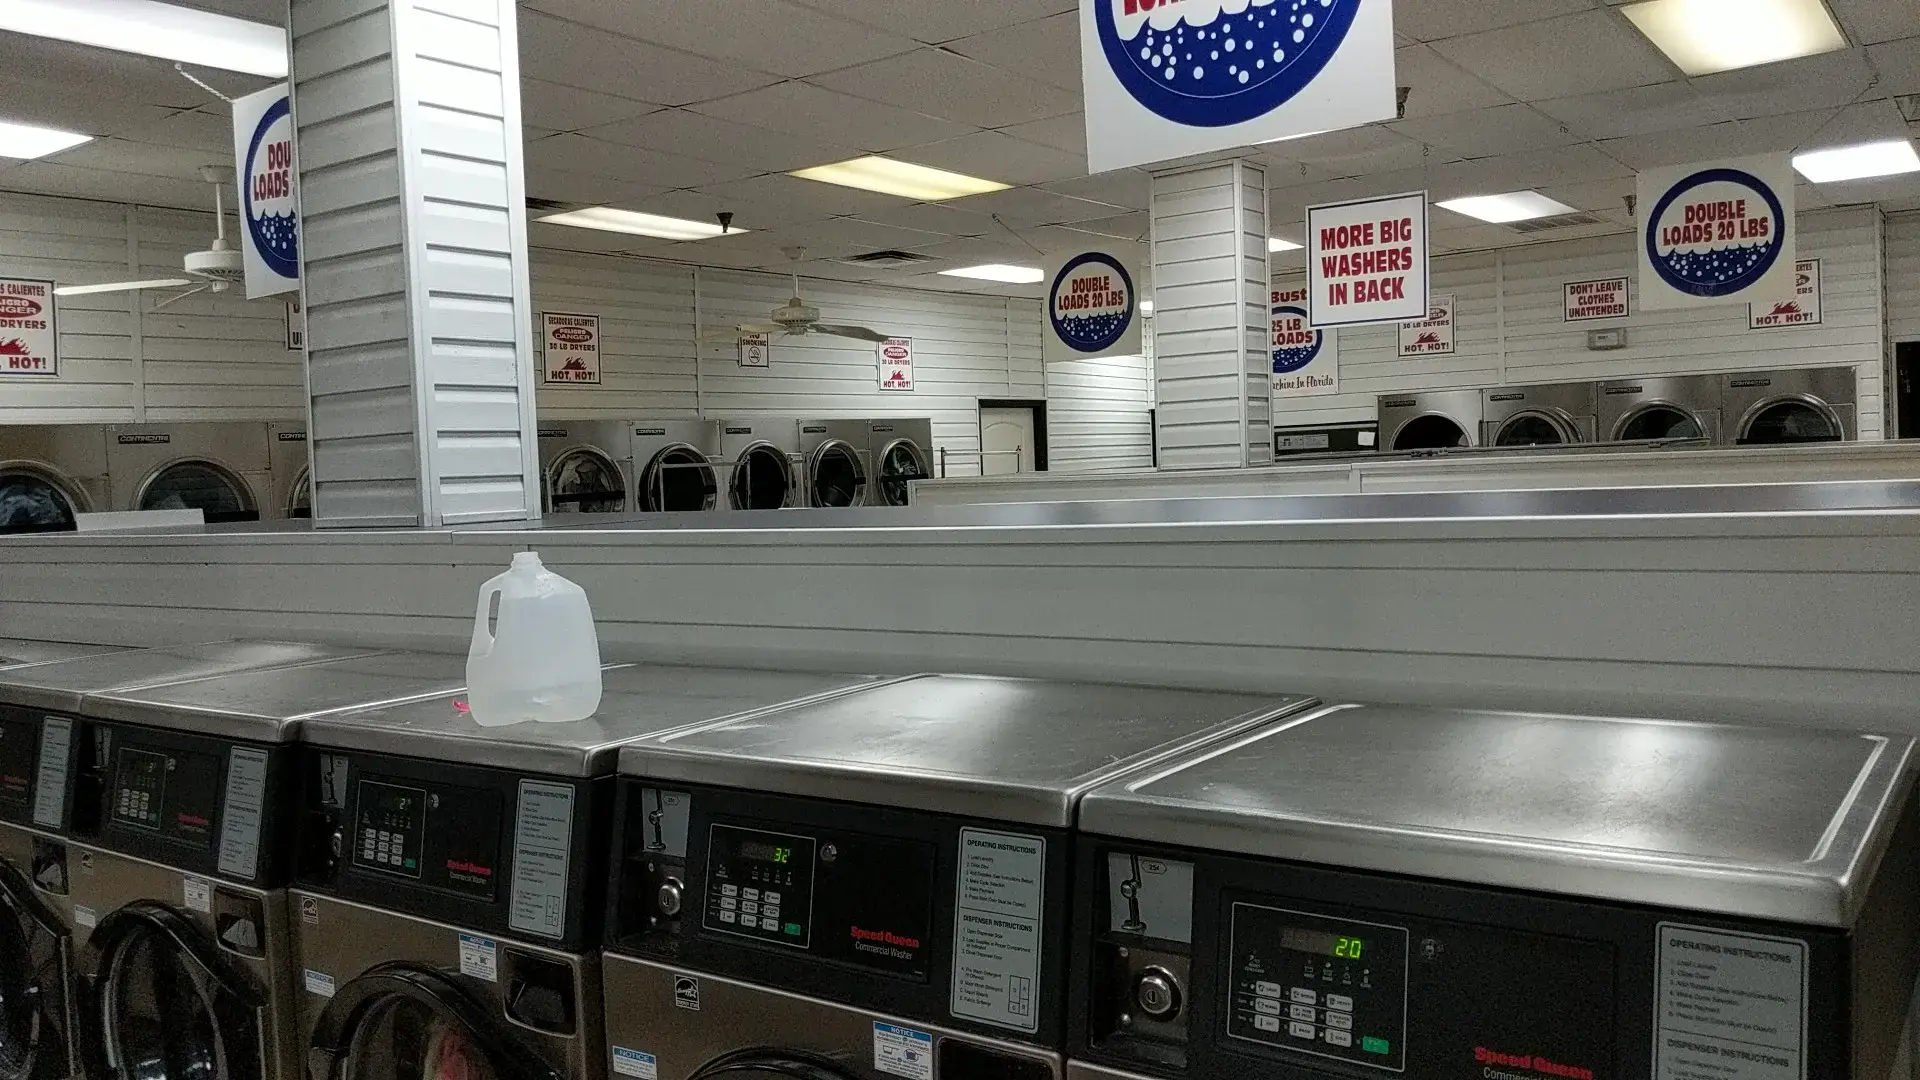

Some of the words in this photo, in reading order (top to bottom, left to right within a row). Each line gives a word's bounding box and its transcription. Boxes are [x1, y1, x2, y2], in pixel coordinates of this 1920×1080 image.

[253, 169, 289, 202] LOADS
[1684, 199, 1746, 225] DOUBLE
[1320, 222, 1374, 251] MORE
[1380, 217, 1412, 244] BIG
[1662, 222, 1712, 246] LOADS
[1717, 220, 1735, 241] 20
[1739, 216, 1769, 239] LBS
[1321, 246, 1413, 279] WASHERS
[7, 283, 45, 296] CALIENTES
[1072, 275, 1110, 294] DOUBLE
[1329, 282, 1348, 306] IN
[1354, 276, 1405, 303] BACK
[1596, 281, 1623, 293] LEAVE
[1058, 293, 1089, 311] LOADS
[1092, 292, 1103, 308] 20
[1105, 290, 1124, 307] LBS
[1578, 293, 1615, 306] CLOTHES
[1568, 304, 1625, 318] UNATTENDED
[1755, 315, 1781, 325] HOT,
[1785, 312, 1813, 323] HOT!
[1286, 318, 1301, 331] LB
[1423, 319, 1450, 328] DRYERS
[569, 344, 596, 352] DRYERS
[742, 339, 767, 348] SMOKING
[1404, 344, 1425, 353] HOT,
[1427, 341, 1450, 351] HOT!
[9, 356, 47, 369] HOT!
[551, 370, 572, 381] HOT,
[575, 371, 596, 381] HOT!
[1296, 376, 1305, 389] In
[1306, 374, 1334, 389] Florida
[967, 840, 997, 850] OPERATING
[997, 844, 1037, 855] INSTRUCTIONS
[963, 914, 993, 926] DISPENSER
[993, 919, 1034, 933] INSTRUCTIONS
[850, 924, 884, 942] Speed
[885, 931, 920, 948] Queen
[855, 940, 890, 955] Commercial
[890, 947, 913, 960] Washer
[1335, 937, 1362, 959] 20
[1669, 938, 1721, 954] OPERATING
[1722, 946, 1792, 964] INSTRUCTIONS
[890, 1026, 914, 1037] NOTICE
[619, 1049, 650, 1063] NOTICE
[1474, 1046, 1532, 1069] Speed
[1667, 1038, 1719, 1055] DISPENSER
[1720, 1047, 1790, 1068] INSTRUCTIONS
